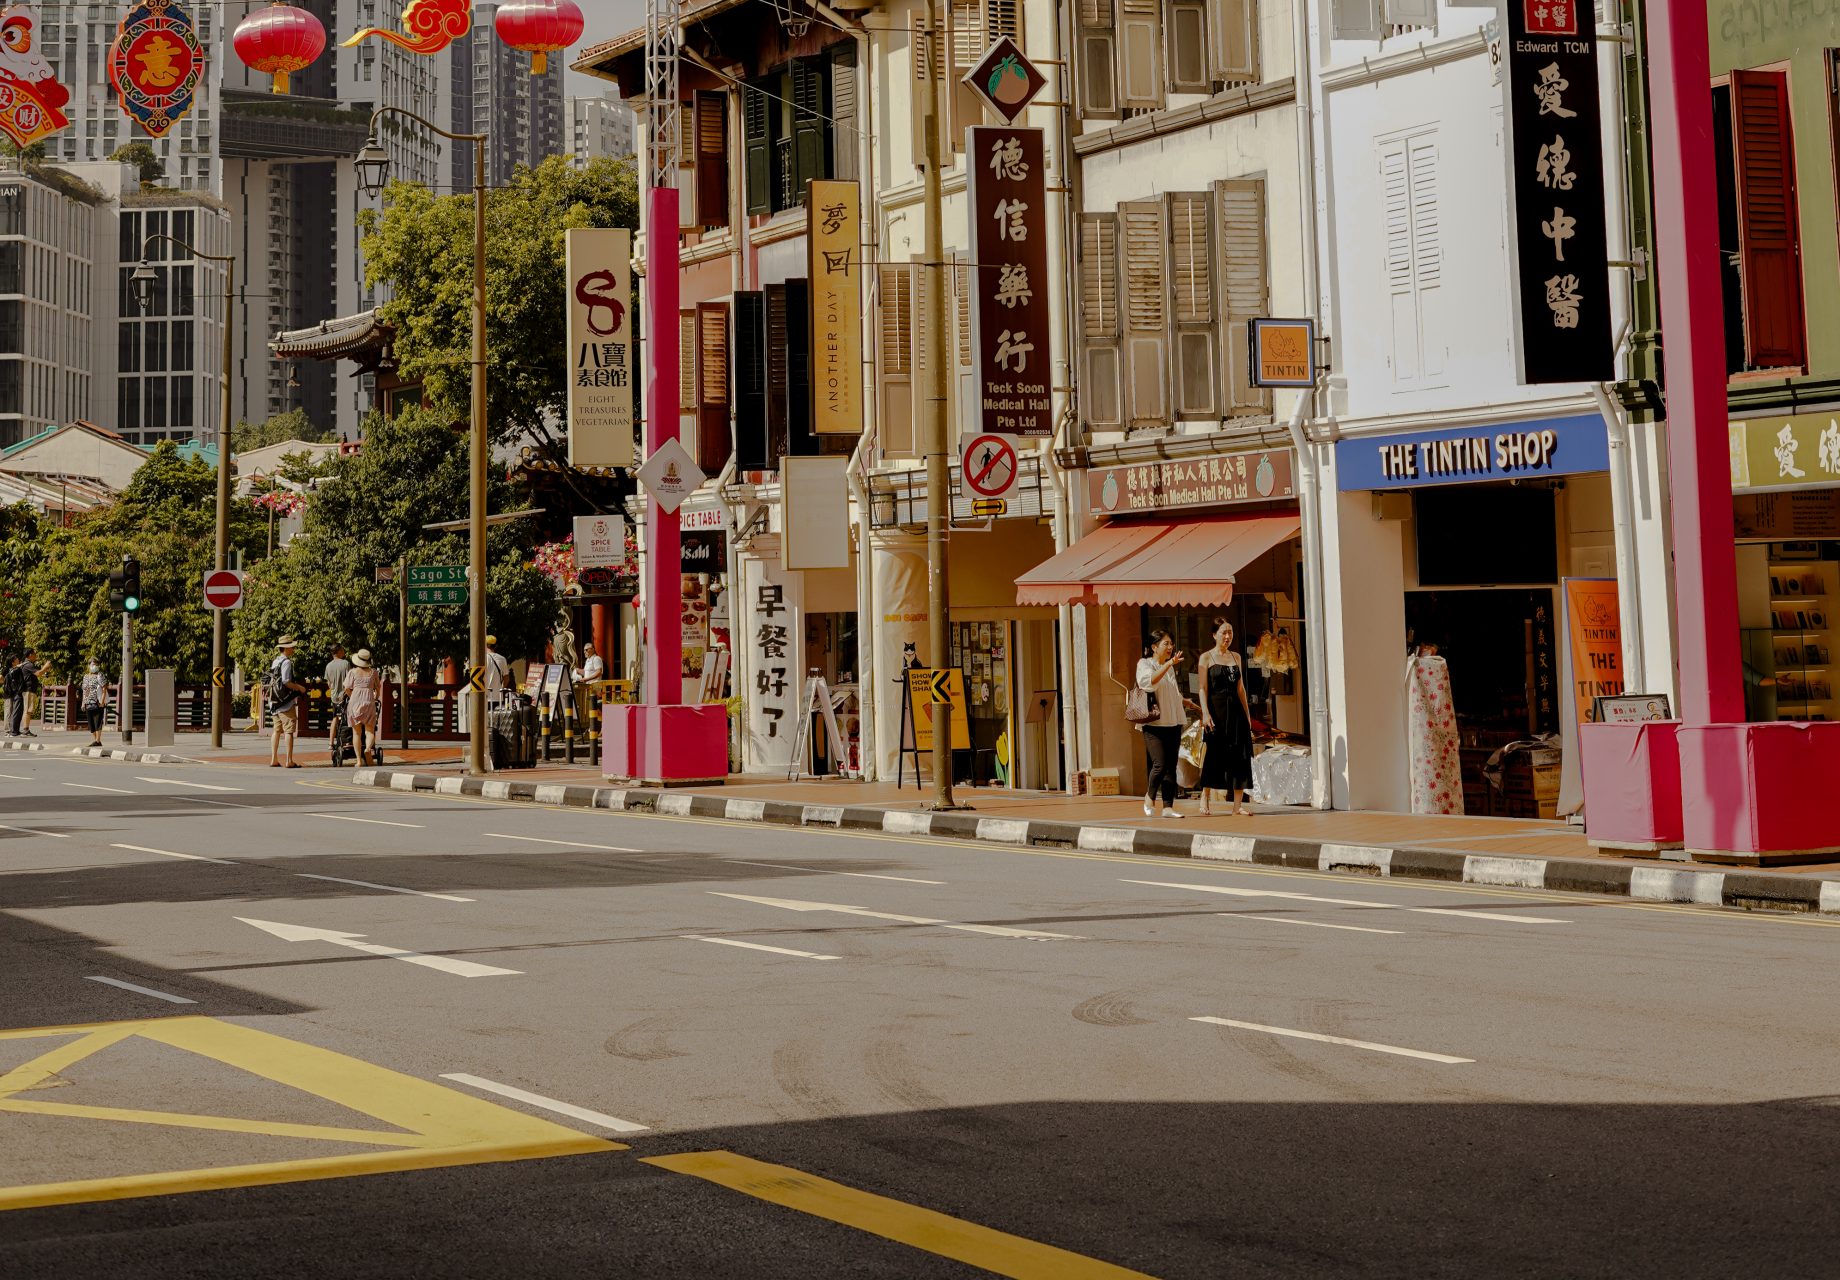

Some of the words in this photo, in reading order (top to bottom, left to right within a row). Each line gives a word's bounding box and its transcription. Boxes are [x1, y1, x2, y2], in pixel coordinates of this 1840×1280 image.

[1516, 40, 1558, 53] Edward
[1564, 41, 1590, 54] TCM
[135, 35, 182, 87] 意
[1533, 61, 1584, 329] 愛德中醫
[990, 136, 1034, 373] 德信藥行
[828, 291, 838, 323] DAY
[578, 342, 626, 368] 八寶
[576, 369, 628, 387] 素食馆
[828, 333, 838, 413] ANOTHER
[1265, 365, 1305, 377] TINTIN
[987, 382, 1013, 394] Teck
[1017, 383, 1044, 394] Soon
[588, 396, 615, 404] EIGHT
[984, 399, 1024, 411] Medical
[1029, 399, 1050, 410] Hall
[579, 406, 627, 414] TREASURES
[576, 418, 630, 426] VEGETARIAN
[997, 416, 1015, 428] Pte
[1019, 416, 1037, 427] Ltd
[1379, 444, 1417, 478] THE
[1421, 438, 1490, 474] TINTIN
[1495, 430, 1556, 470] SHOP
[1128, 493, 1146, 508] Teck
[1149, 491, 1168, 507] Soon
[1170, 487, 1200, 504] Medical
[1201, 485, 1216, 501] Hall
[1218, 484, 1232, 499] Pte
[1234, 483, 1248, 498] Ltd
[698, 510, 721, 526] TABLE
[411, 569, 442, 582] Sago
[448, 568, 461, 579] St
[583, 571, 611, 583] OPEN
[1584, 628, 1616, 639] TINTIN
[756, 584, 789, 738] 早餐好了
[1589, 653, 1616, 669] THE
